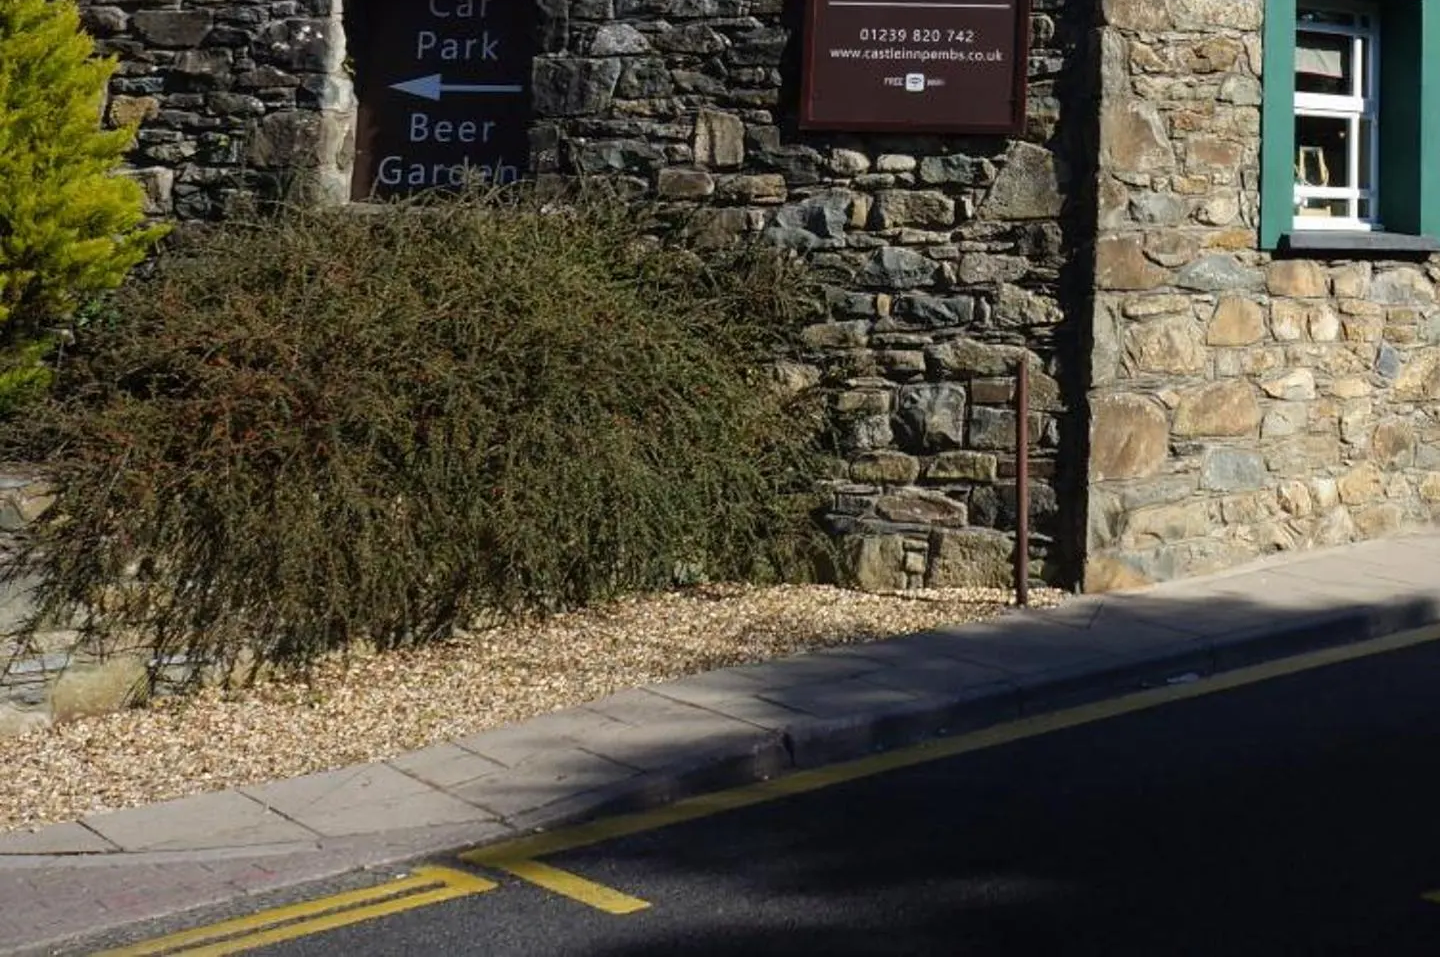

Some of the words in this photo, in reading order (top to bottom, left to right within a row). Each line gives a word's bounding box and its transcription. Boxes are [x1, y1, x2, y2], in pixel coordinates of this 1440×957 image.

[417, 31, 500, 61] Park
[859, 28, 907, 42] 01239
[912, 28, 941, 43] 820
[947, 29, 975, 43] 742
[410, 113, 495, 142] Beer
